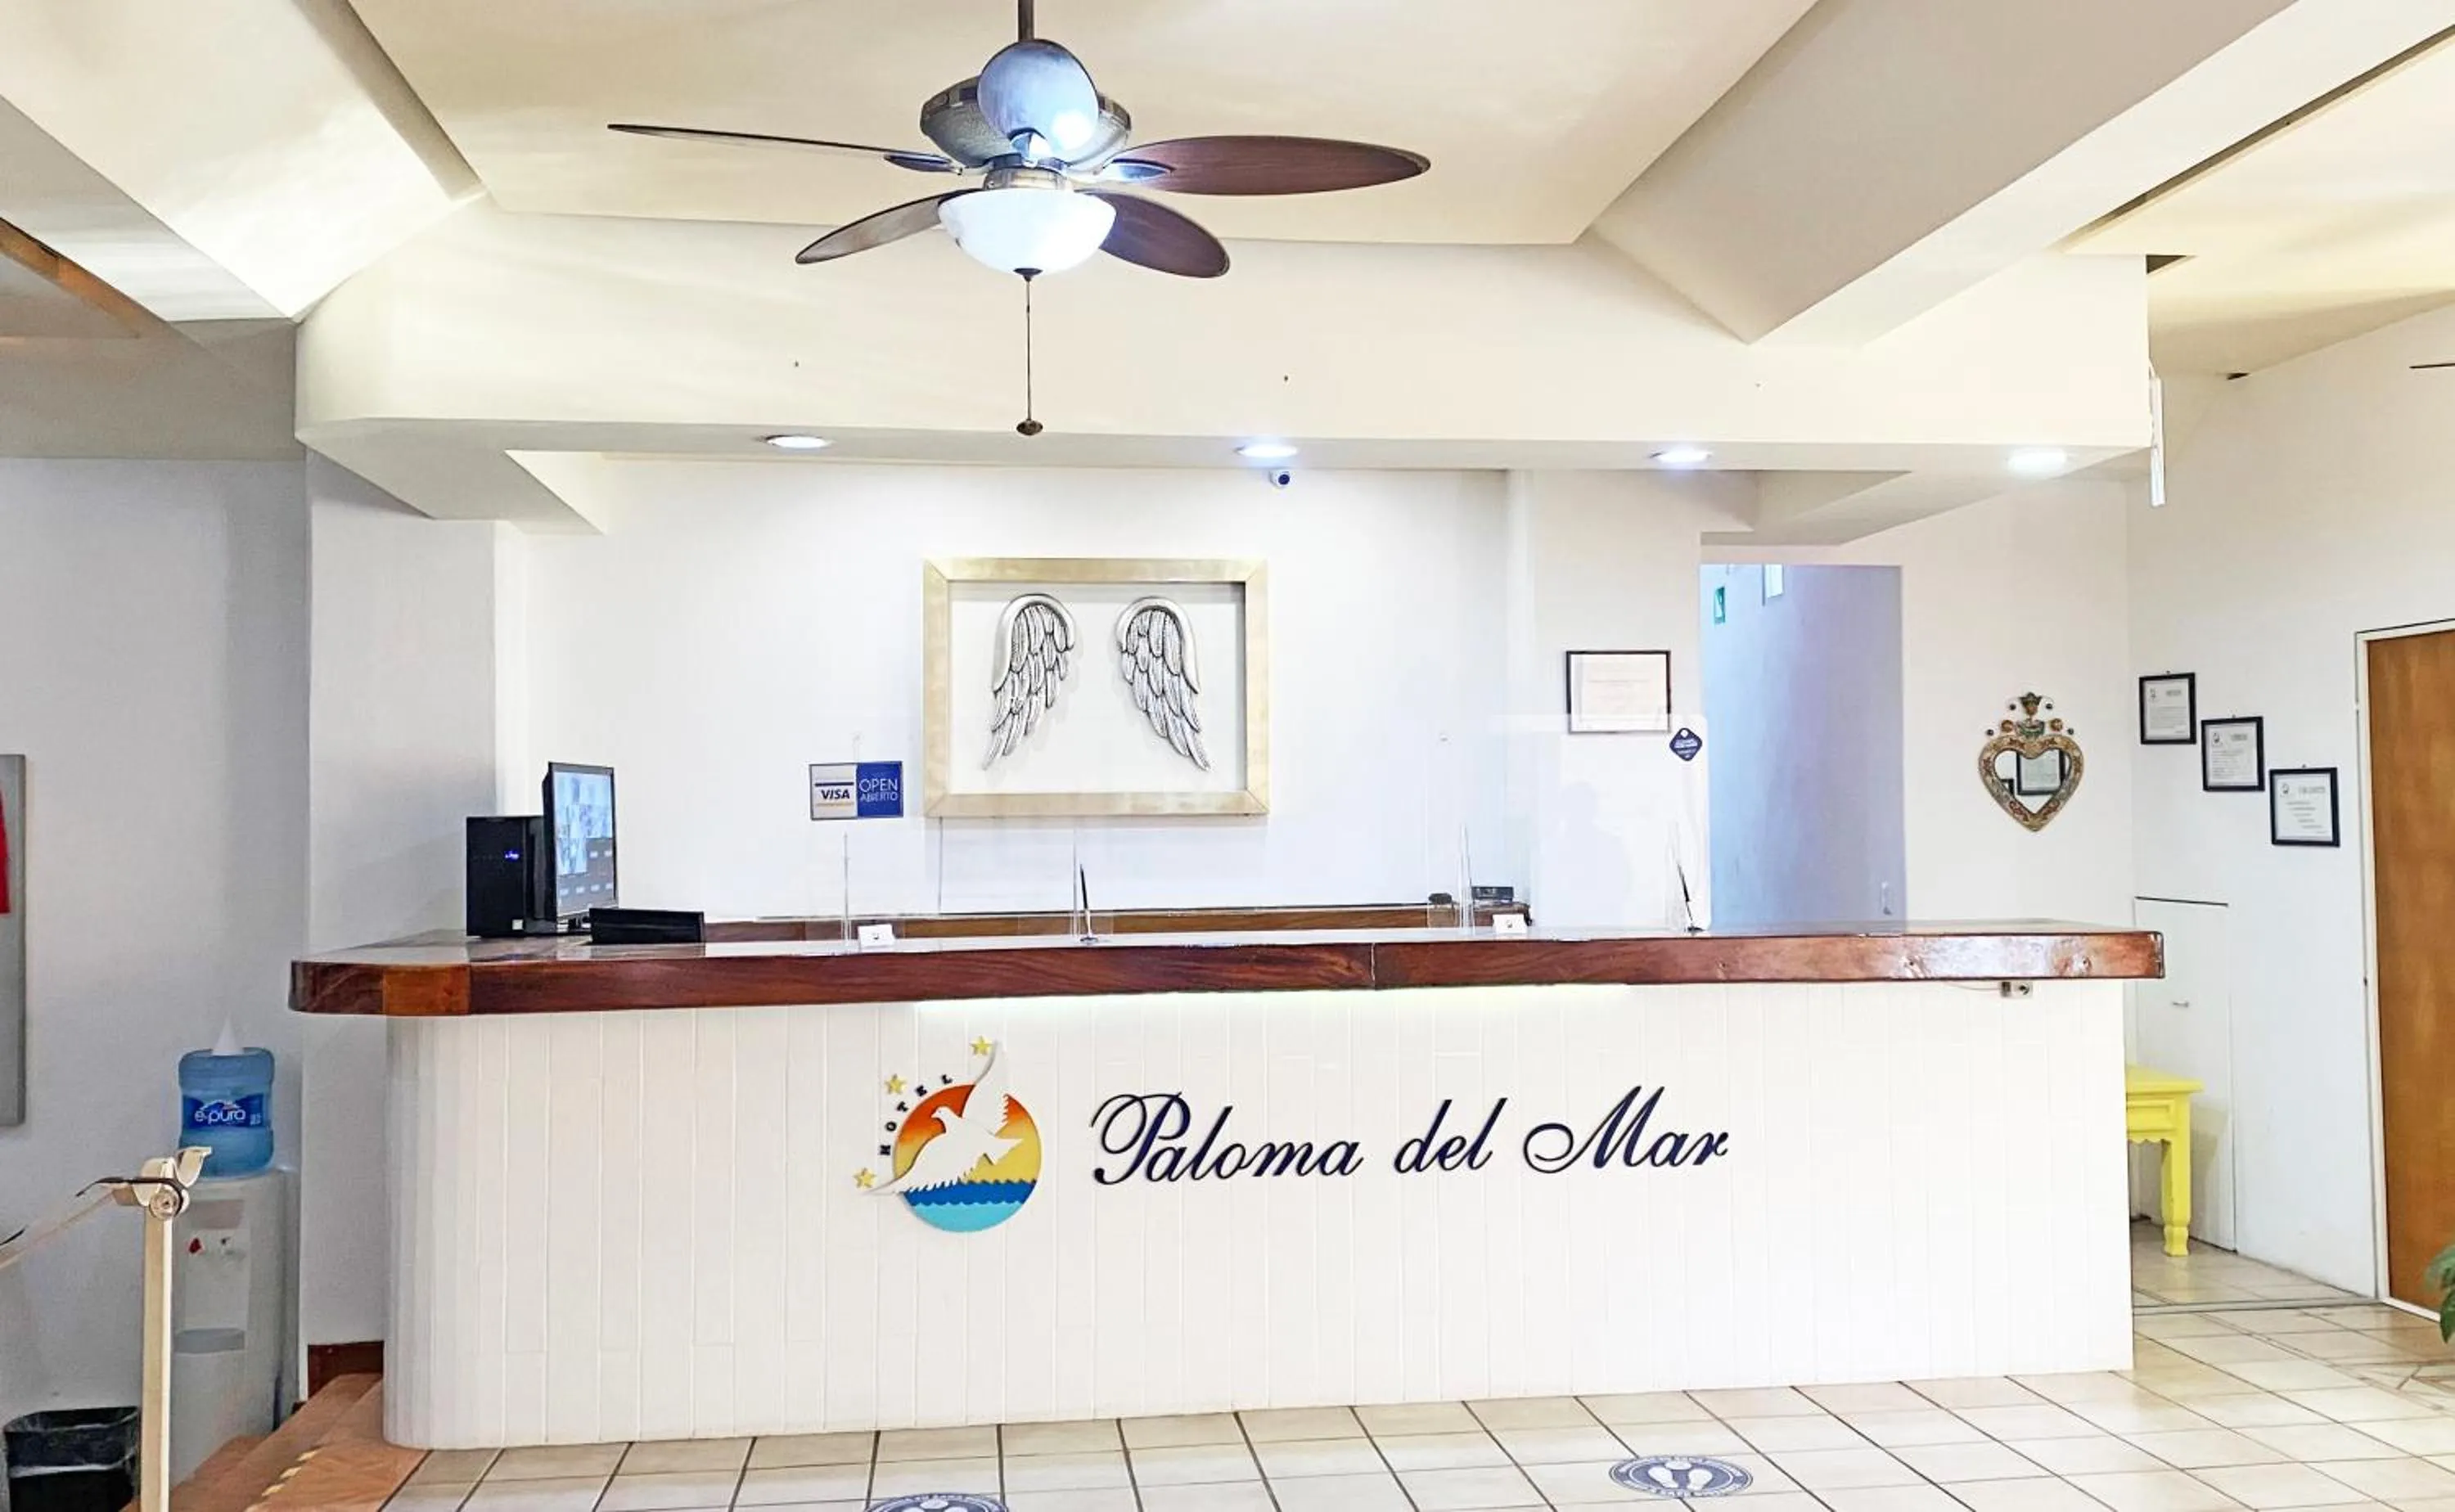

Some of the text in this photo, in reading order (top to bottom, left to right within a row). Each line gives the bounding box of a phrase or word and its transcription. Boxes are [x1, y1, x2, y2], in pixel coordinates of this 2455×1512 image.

[859, 778, 899, 793] OPEN
[821, 789, 850, 800] VISA
[860, 792, 899, 803] ABIERTO
[880, 1073, 953, 1157] HOTEL
[1091, 1086, 1729, 1186] Paloma del Mar
